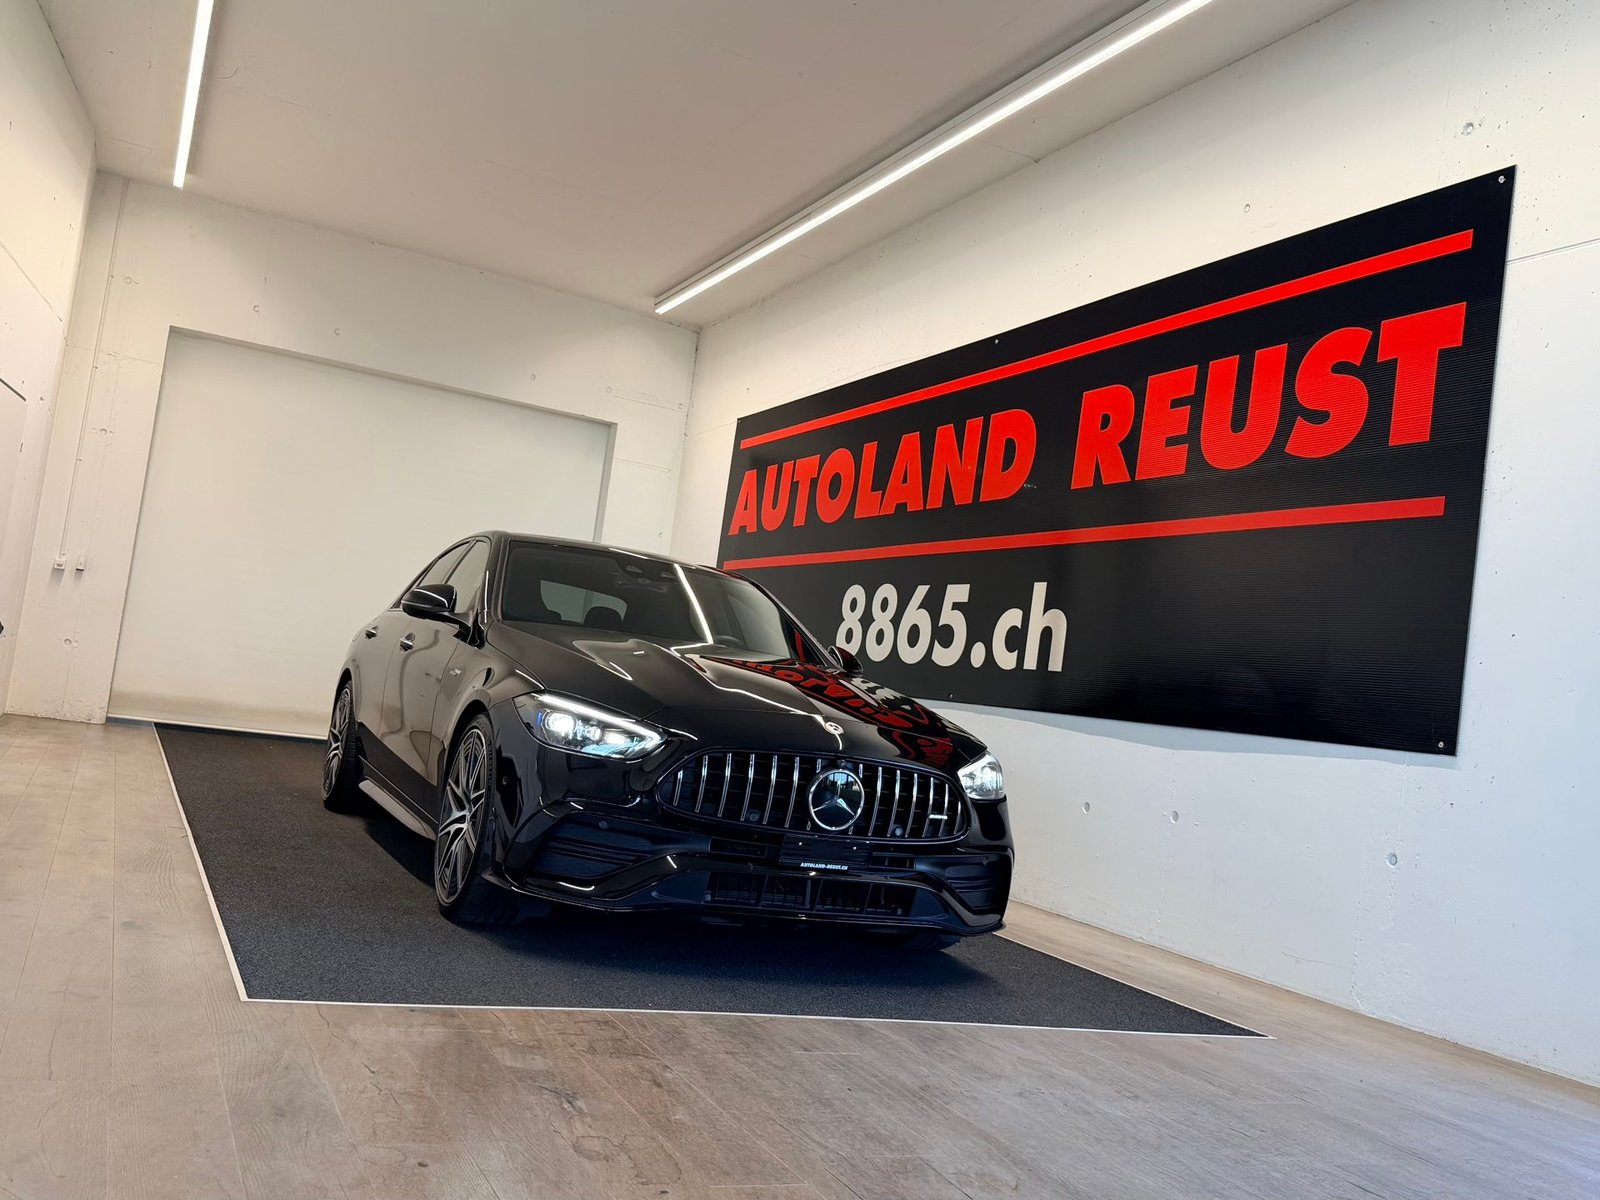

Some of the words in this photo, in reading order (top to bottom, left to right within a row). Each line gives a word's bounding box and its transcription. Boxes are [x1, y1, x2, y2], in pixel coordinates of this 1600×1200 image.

[728, 408, 1037, 536] AUTOLAND
[1070, 301, 1467, 490] REUST
[835, 581, 1068, 672] 8865.ch
